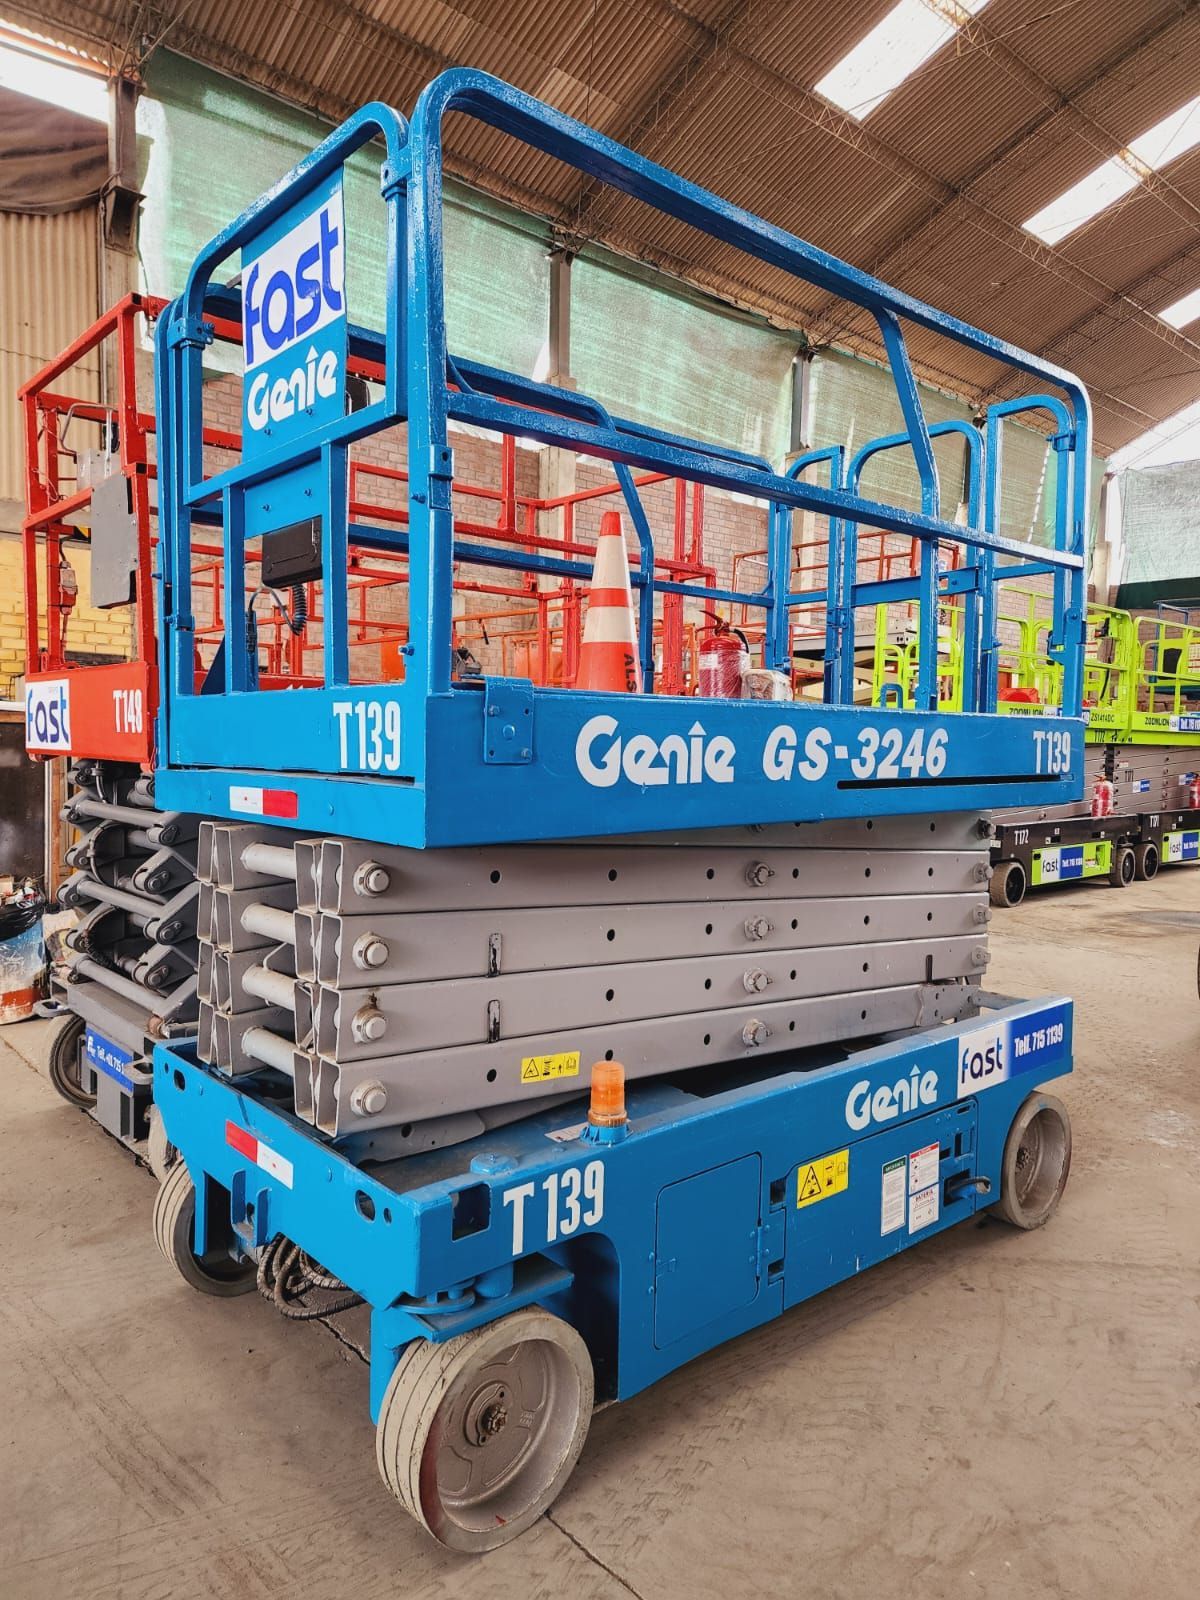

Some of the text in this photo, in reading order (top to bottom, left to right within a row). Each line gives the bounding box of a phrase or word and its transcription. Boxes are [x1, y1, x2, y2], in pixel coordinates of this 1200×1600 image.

[245, 208, 342, 366] fast
[247, 345, 338, 431] Genie
[28, 686, 70, 744] fast
[112, 688, 143, 734] T148
[332, 701, 401, 771] T139
[575, 715, 949, 788] Genie GS-3246
[1033, 730, 1071, 774] T139
[961, 1036, 1003, 1084] fast
[1032, 1029, 1045, 1051] 715
[1046, 1022, 1064, 1047] 1139
[845, 1064, 939, 1131] Genie
